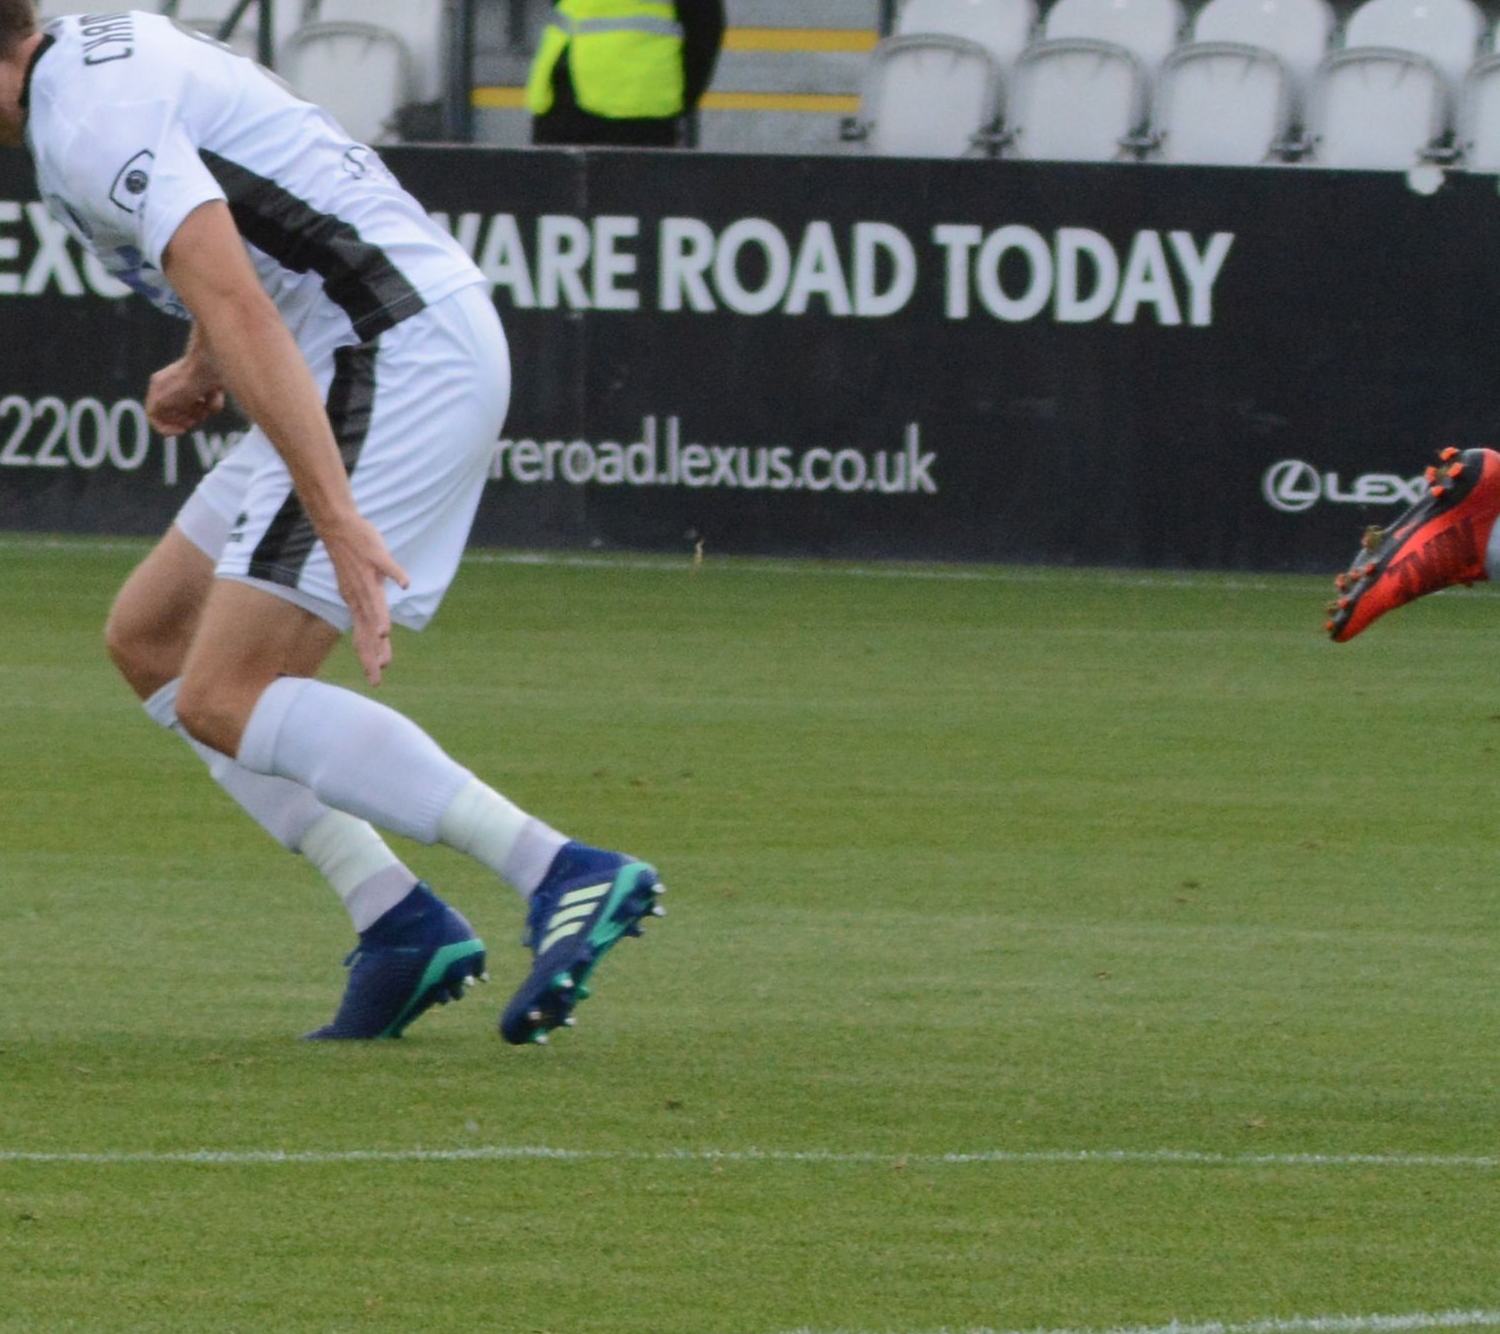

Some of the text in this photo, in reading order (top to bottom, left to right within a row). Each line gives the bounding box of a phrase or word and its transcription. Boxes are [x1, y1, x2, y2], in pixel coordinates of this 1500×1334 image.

[658, 215, 918, 318] ROAD
[931, 223, 1236, 328] TODAY
[1324, 471, 1431, 504] LEX
